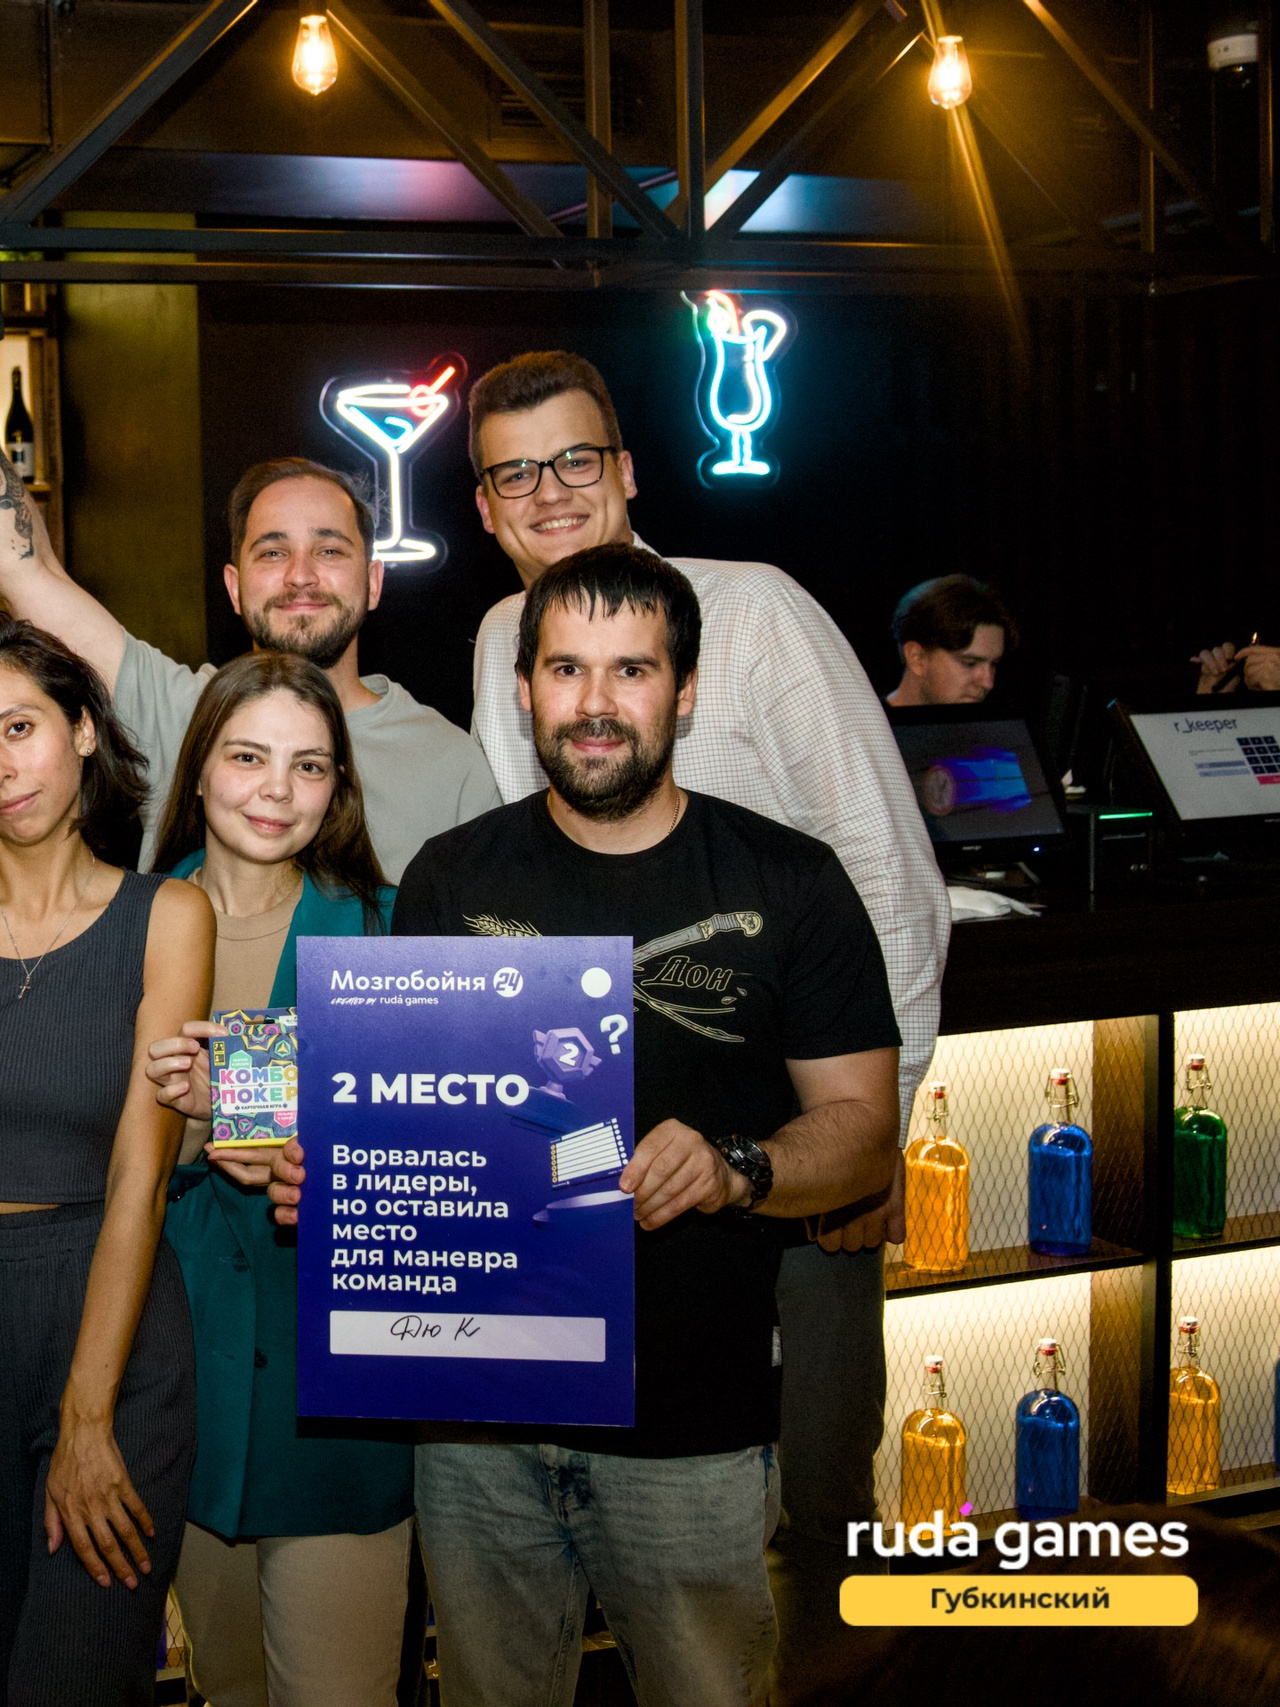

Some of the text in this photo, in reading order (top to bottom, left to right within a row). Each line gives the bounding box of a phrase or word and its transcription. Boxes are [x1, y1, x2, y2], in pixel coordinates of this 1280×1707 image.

[1173, 718, 1238, 733] r_keeper
[330, 969, 521, 992] Мозгобойня 24
[640, 955, 734, 991] Дон
[404, 998, 439, 1007] games
[559, 1043, 579, 1067] 2
[220, 1066, 298, 1085] КОМБО
[221, 1086, 298, 1105] ПОКЕР
[331, 1071, 530, 1107] 2 МЕСТО
[332, 1144, 488, 1171] Ворвалась
[332, 1173, 478, 1197] в лидеры,
[332, 1199, 510, 1219] но оставила
[332, 1223, 418, 1242] место
[331, 1248, 518, 1274] для маневра
[332, 1273, 457, 1295] команда
